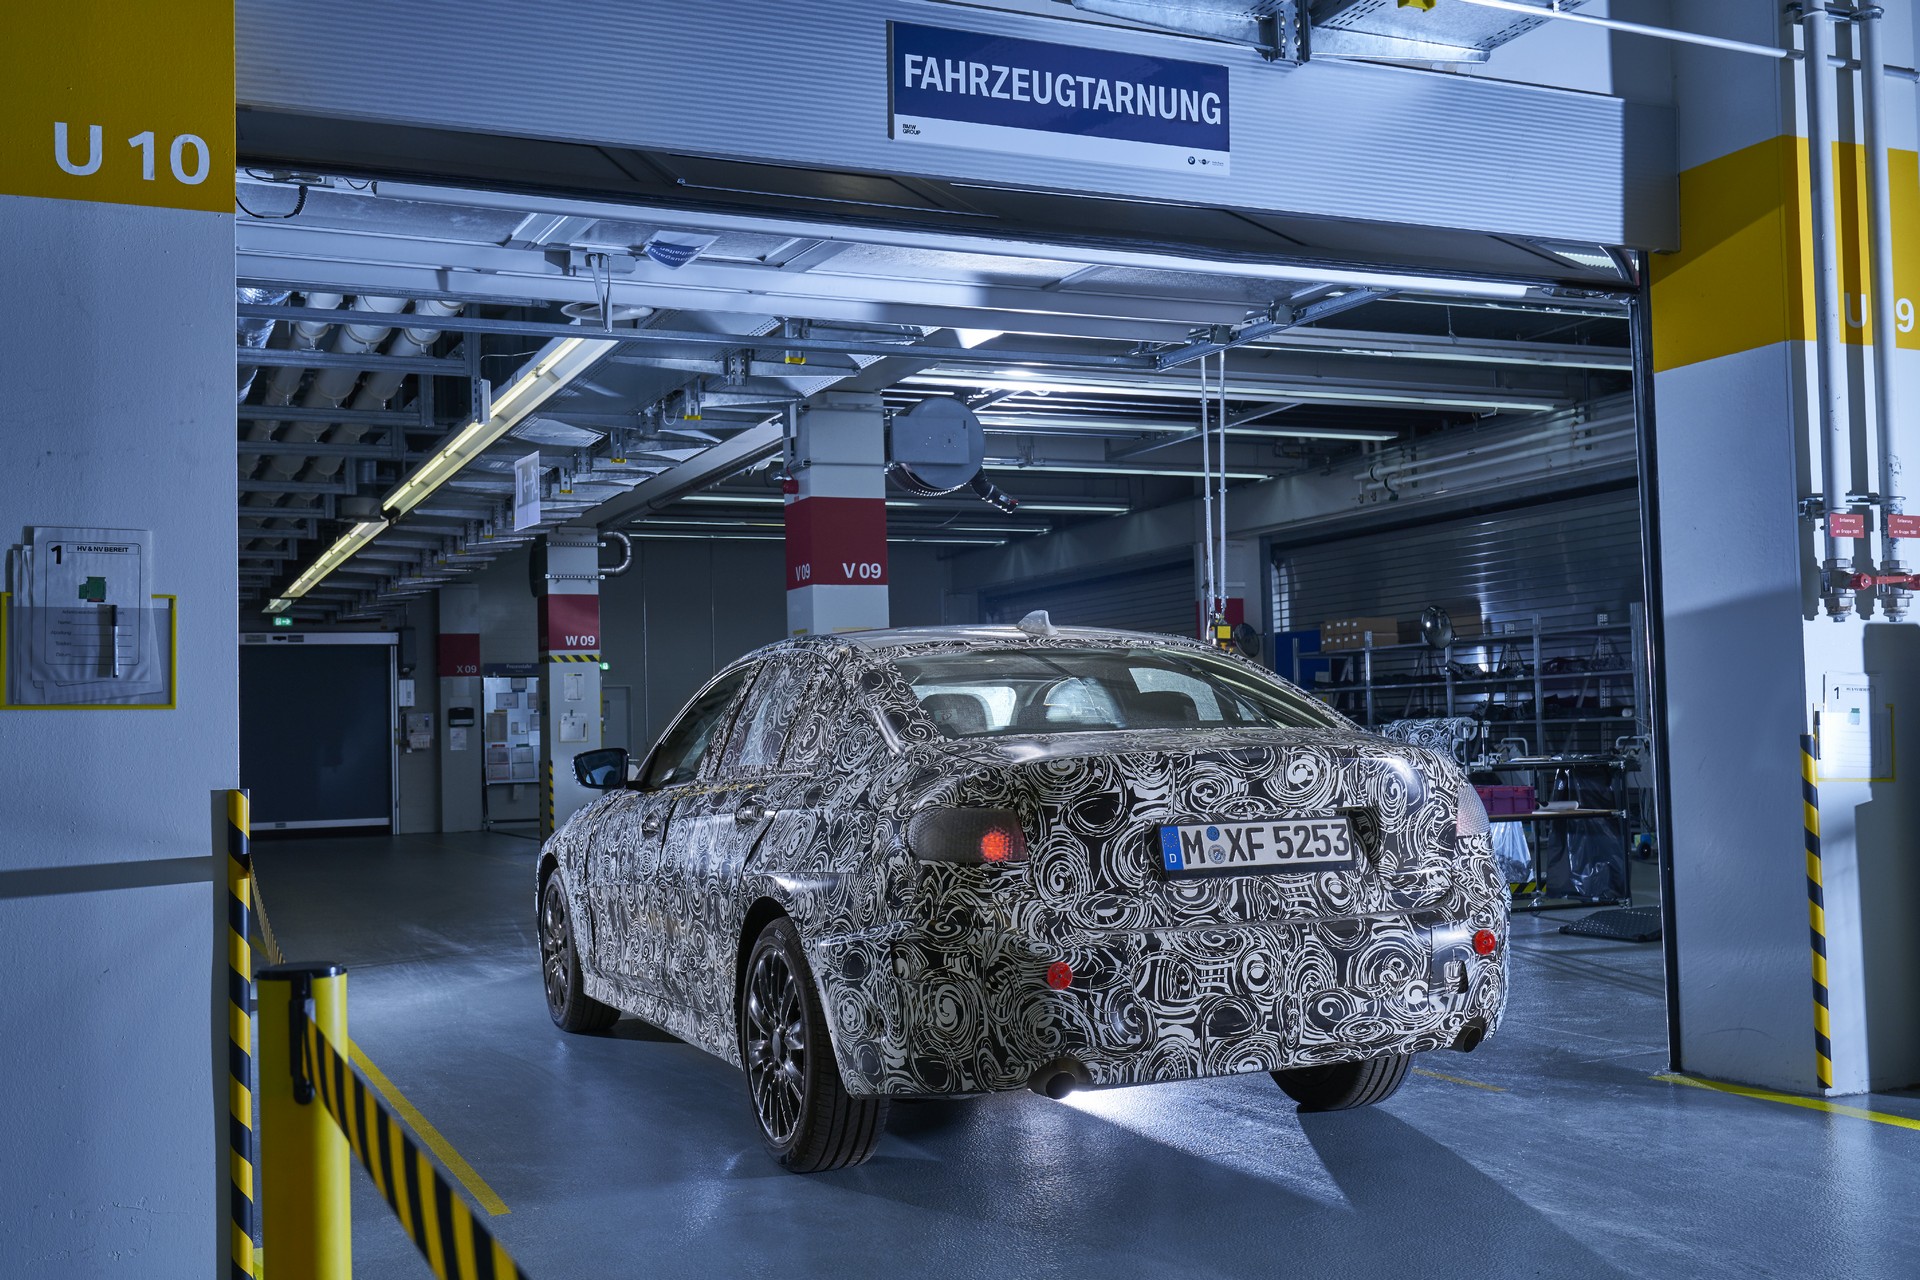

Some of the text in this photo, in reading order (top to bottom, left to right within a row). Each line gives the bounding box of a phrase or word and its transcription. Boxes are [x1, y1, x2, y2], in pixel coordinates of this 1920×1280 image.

[904, 53, 1222, 125] FAHRZEUGTARNUNG
[54, 121, 210, 185] U 10
[1844, 292, 1915, 333] U 9
[51, 545, 62, 565] 1
[795, 563, 811, 582] V 09
[842, 562, 882, 579] V 09
[565, 635, 596, 647] W 09
[456, 664, 477, 674] X 09
[1833, 686, 1840, 700] 1
[1180, 829, 1207, 865] M
[1223, 826, 1265, 863] XF
[1273, 823, 1351, 859] 5253
[1169, 853, 1177, 864] D
